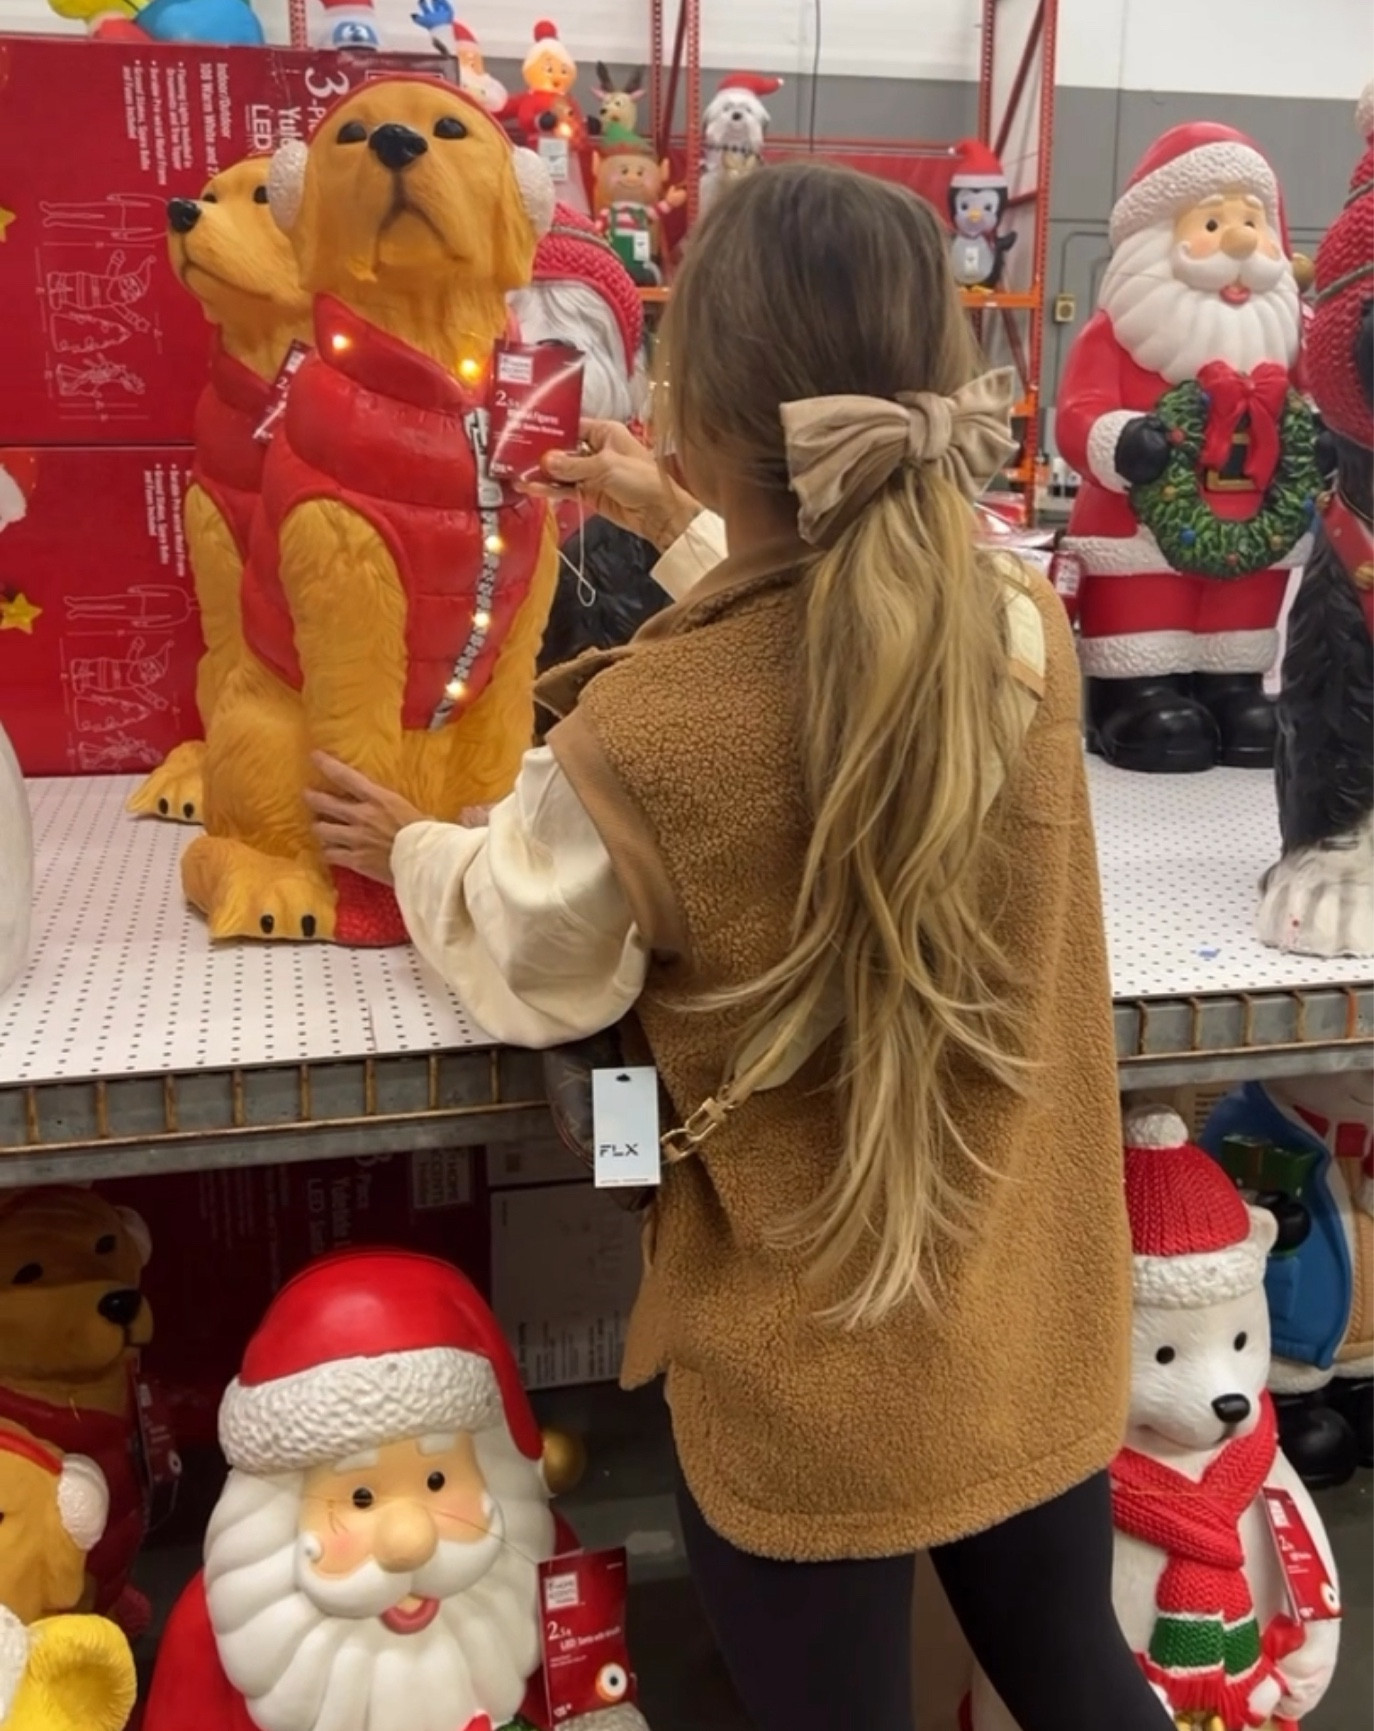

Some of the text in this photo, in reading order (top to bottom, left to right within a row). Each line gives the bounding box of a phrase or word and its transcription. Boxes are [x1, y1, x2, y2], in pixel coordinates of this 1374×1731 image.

[201, 82, 214, 112] Warm
[217, 63, 231, 139] Indoor/Outdoor
[203, 115, 216, 142] White
[252, 104, 272, 150] LED
[206, 145, 218, 164] and
[600, 1144, 638, 1157] FLX
